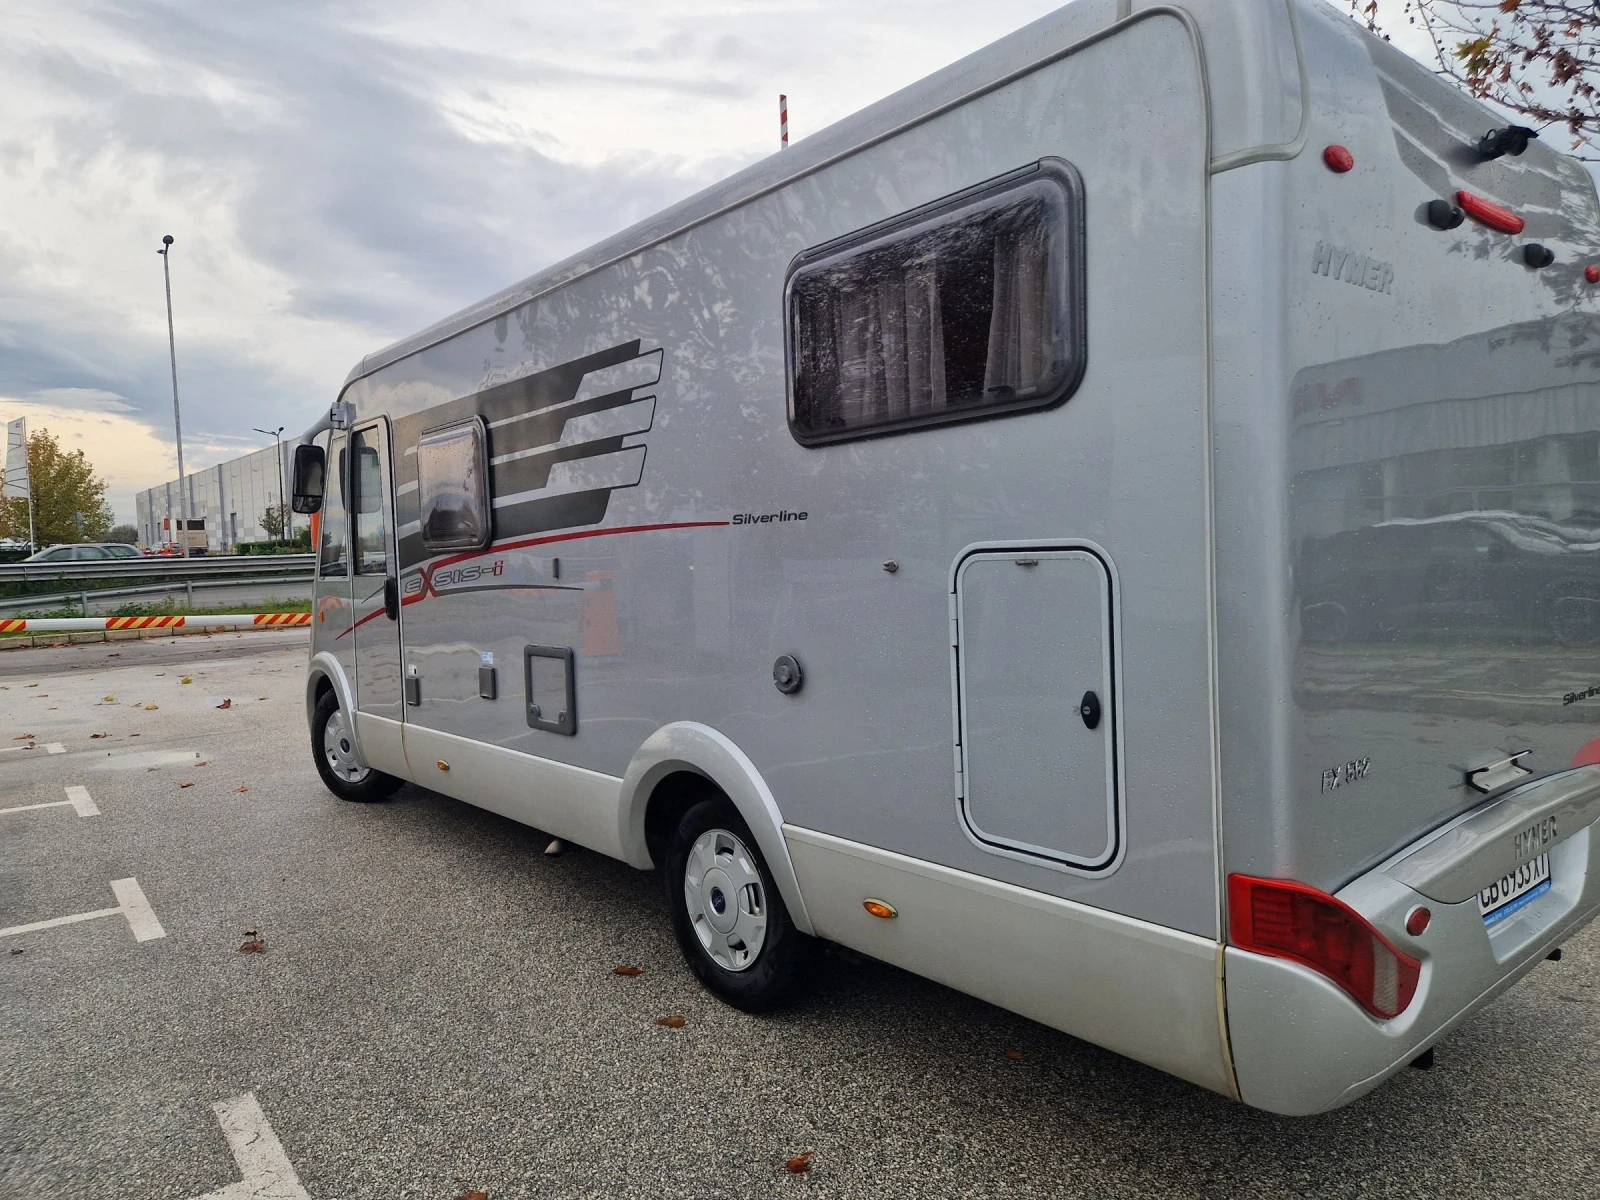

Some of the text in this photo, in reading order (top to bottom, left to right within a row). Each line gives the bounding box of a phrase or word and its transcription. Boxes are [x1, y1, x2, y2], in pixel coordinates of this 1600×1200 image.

[1311, 240, 1394, 295] HYMER
[732, 510, 808, 525] Silverline
[1321, 765, 1342, 794] EX
[1514, 815, 1558, 861] HYMER
